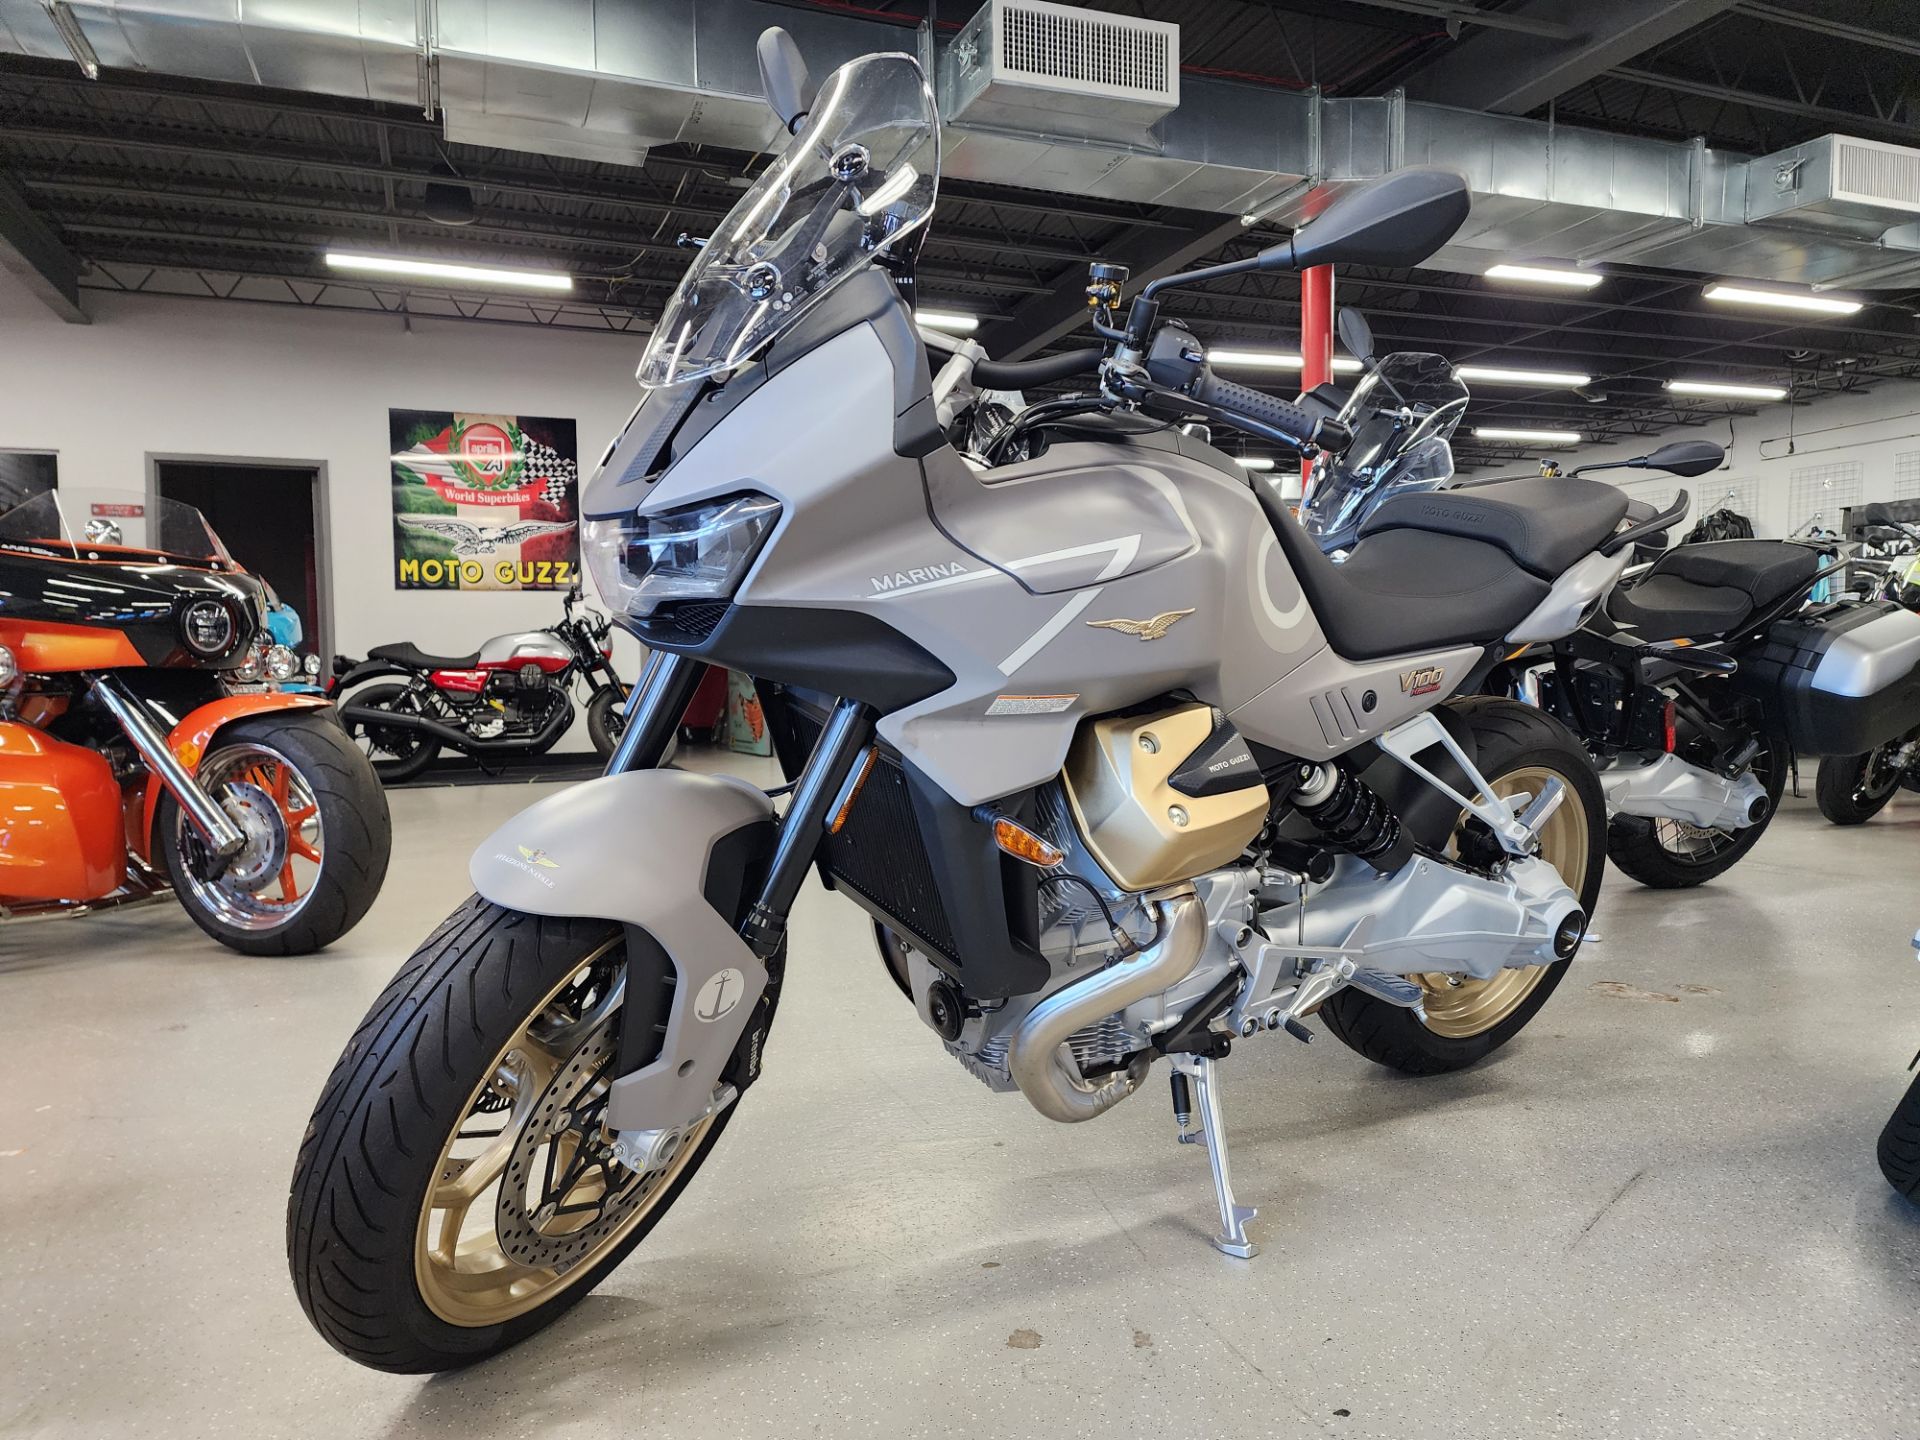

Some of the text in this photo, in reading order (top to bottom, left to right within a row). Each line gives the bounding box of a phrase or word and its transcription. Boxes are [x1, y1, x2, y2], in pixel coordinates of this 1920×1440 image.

[471, 443, 499, 454] aprilia
[445, 488, 530, 505] World Superbikes
[400, 559, 483, 584] MOTO
[870, 561, 968, 592] MARINA
[1399, 667, 1445, 692] V100
[1208, 753, 1250, 773] MOTO GUZZI
[749, 1027, 762, 1077] brembo
